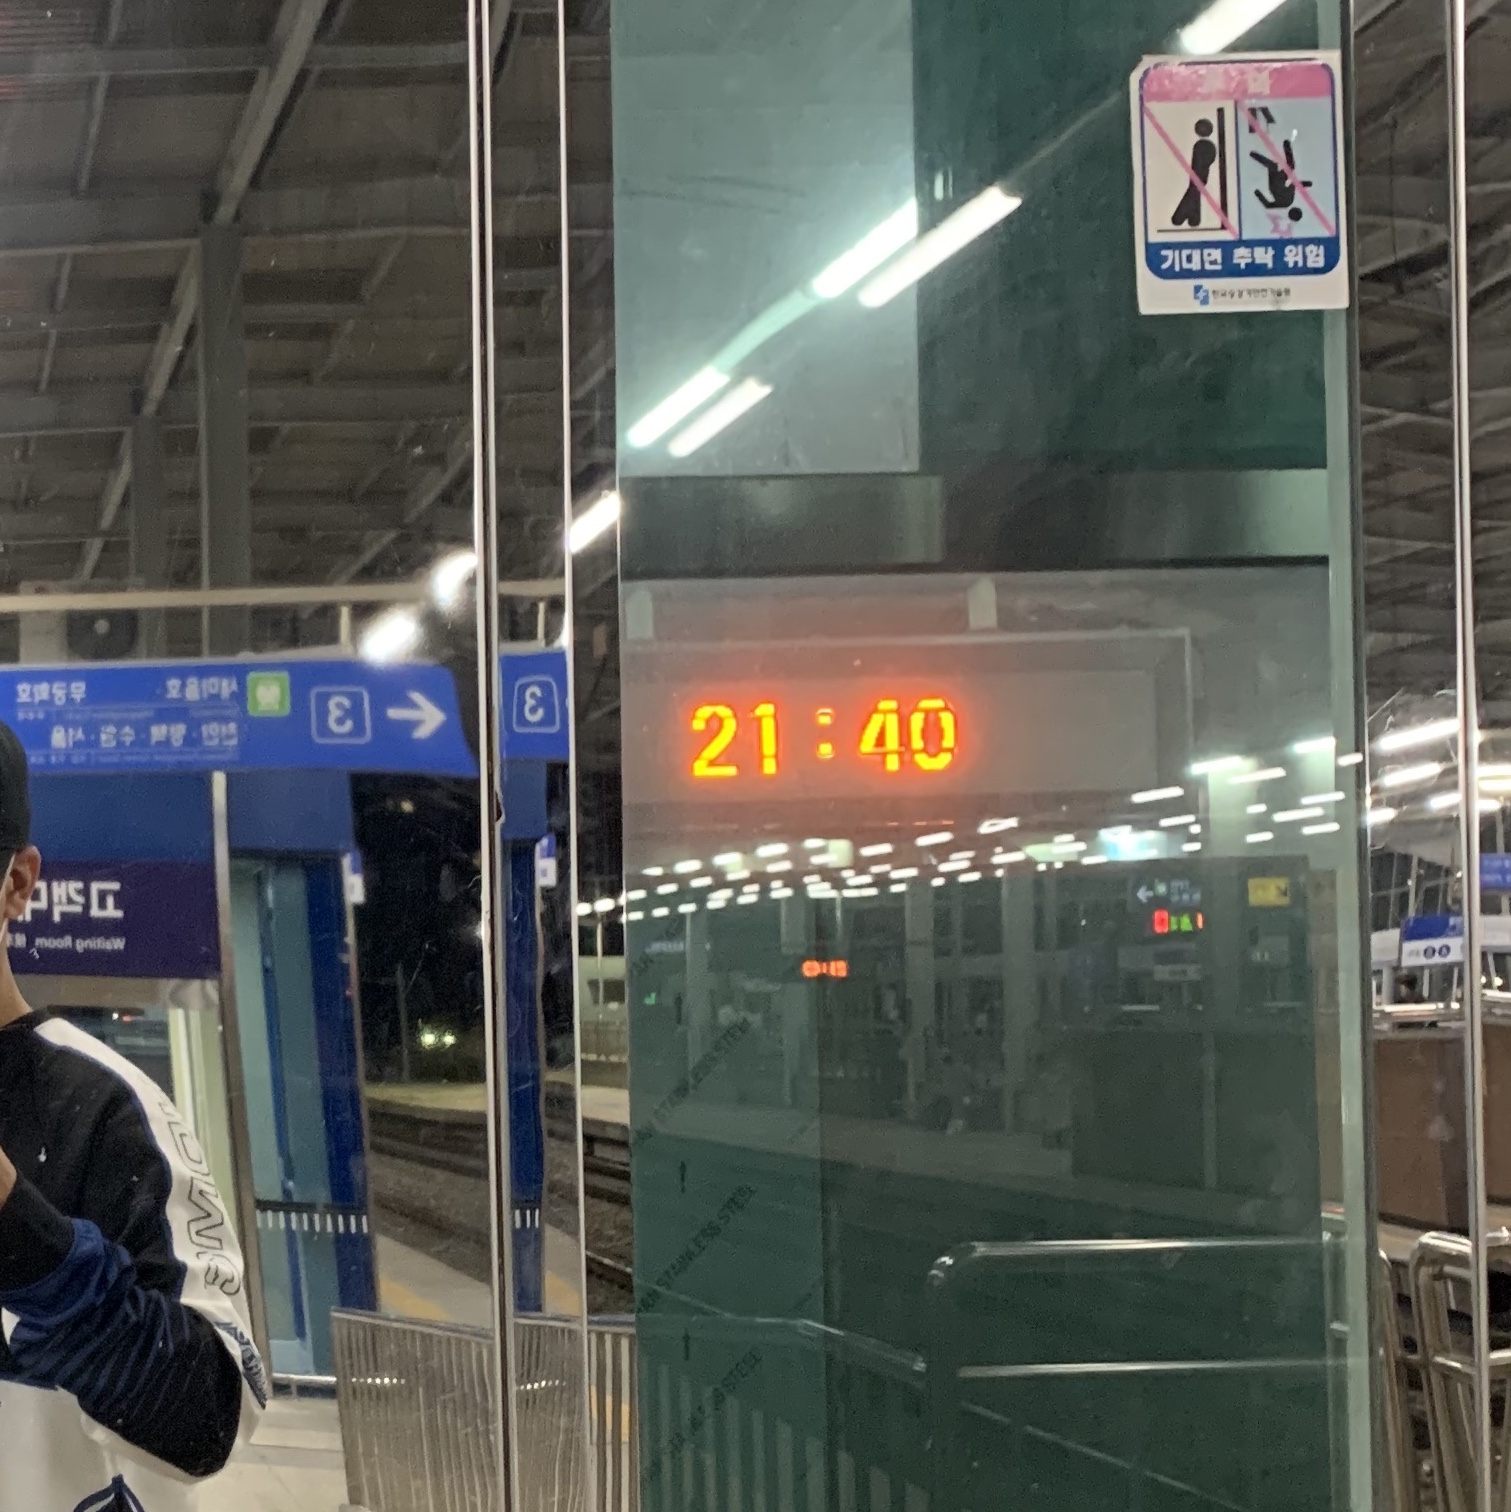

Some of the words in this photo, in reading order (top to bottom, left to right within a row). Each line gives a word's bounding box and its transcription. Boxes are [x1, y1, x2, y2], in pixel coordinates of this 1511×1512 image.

[1159, 247, 1223, 272] 기대면
[1232, 246, 1276, 270] 추락
[1283, 244, 1326, 269] 위험
